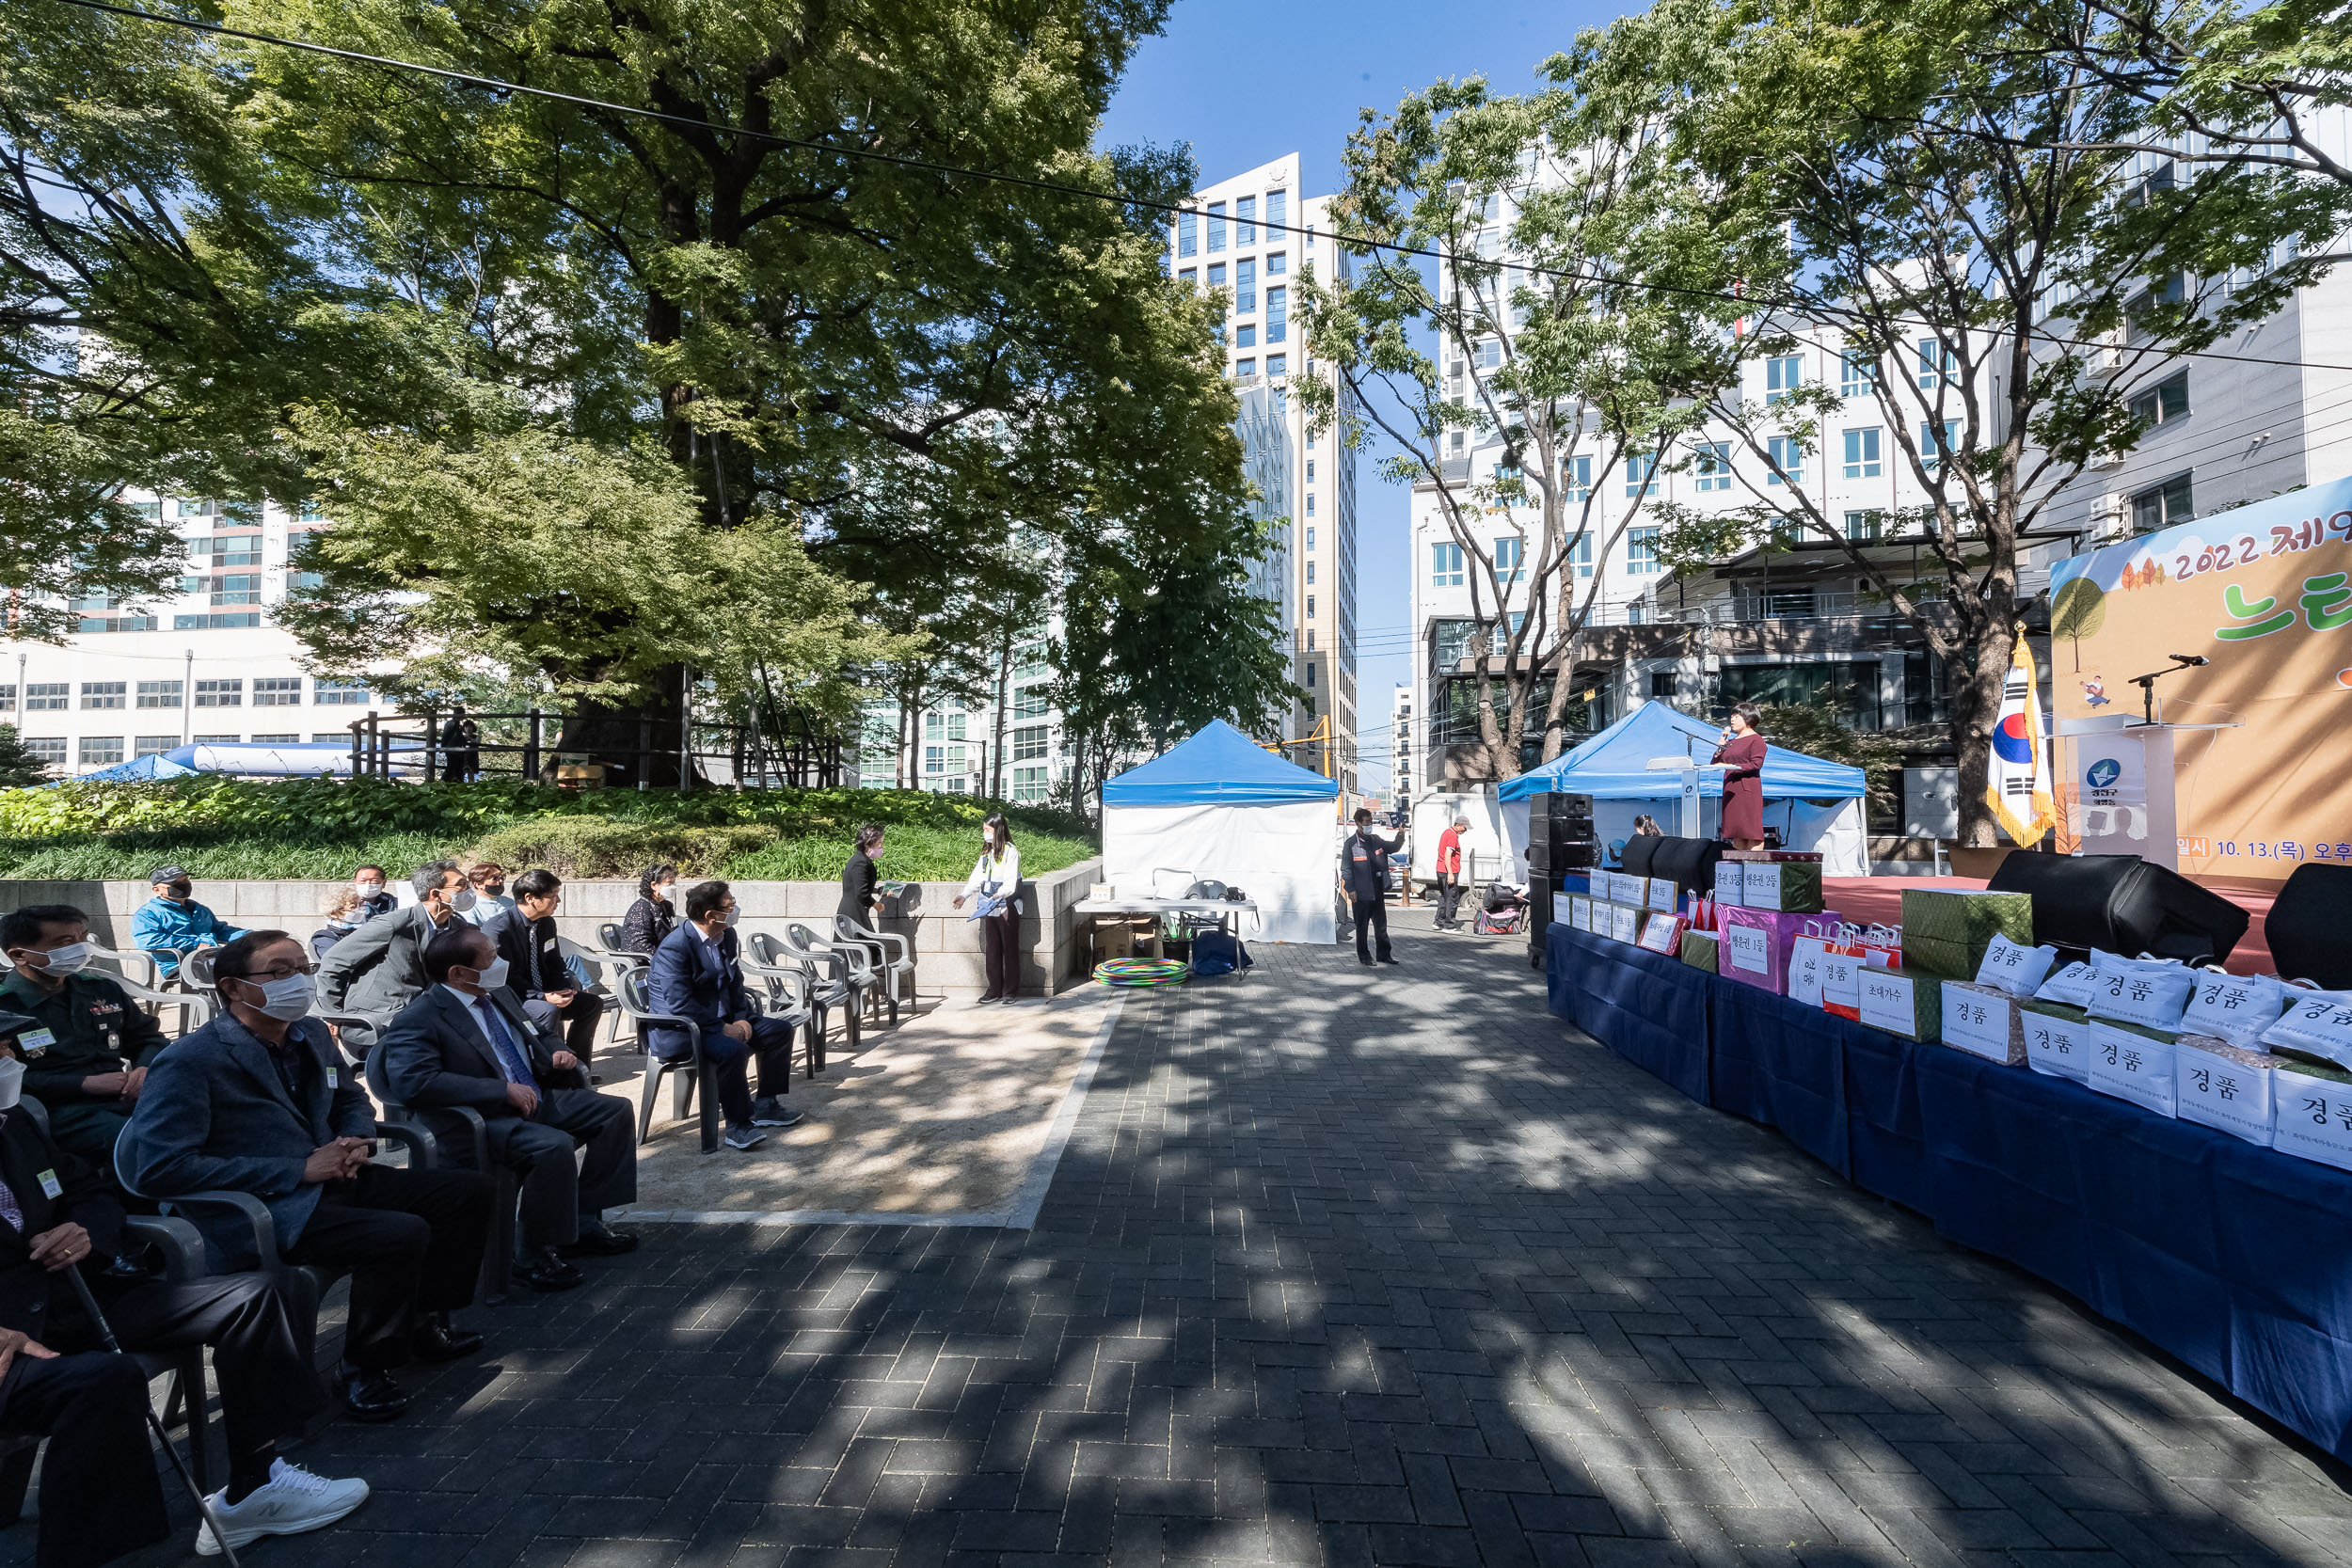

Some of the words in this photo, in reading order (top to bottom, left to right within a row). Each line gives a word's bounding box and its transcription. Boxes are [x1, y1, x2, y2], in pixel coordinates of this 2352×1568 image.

[2175, 536, 2260, 580] 2022
[2176, 837, 2206, 856] 일시
[2217, 841, 2240, 856] 10.
[2248, 840, 2305, 862] 13.(목)
[2313, 842, 2352, 862] 오후
[1716, 872, 1728, 885] 운권
[1766, 875, 1777, 887] 2등
[1732, 935, 1750, 950] 행운권
[1754, 940, 1764, 953] 1등
[1990, 945, 2025, 967] 경품
[1804, 958, 1816, 987] 경품
[1826, 964, 1849, 982] 경품
[2067, 966, 2100, 981] 경품
[1868, 984, 1902, 1003] 초대가수
[2104, 974, 2153, 1002] 경품
[2200, 984, 2249, 1010] 경품
[1956, 1002, 1988, 1025] 경품
[2034, 1029, 2073, 1054] 경품
[2100, 1043, 2143, 1072] 경품
[2190, 1068, 2240, 1101] 경품
